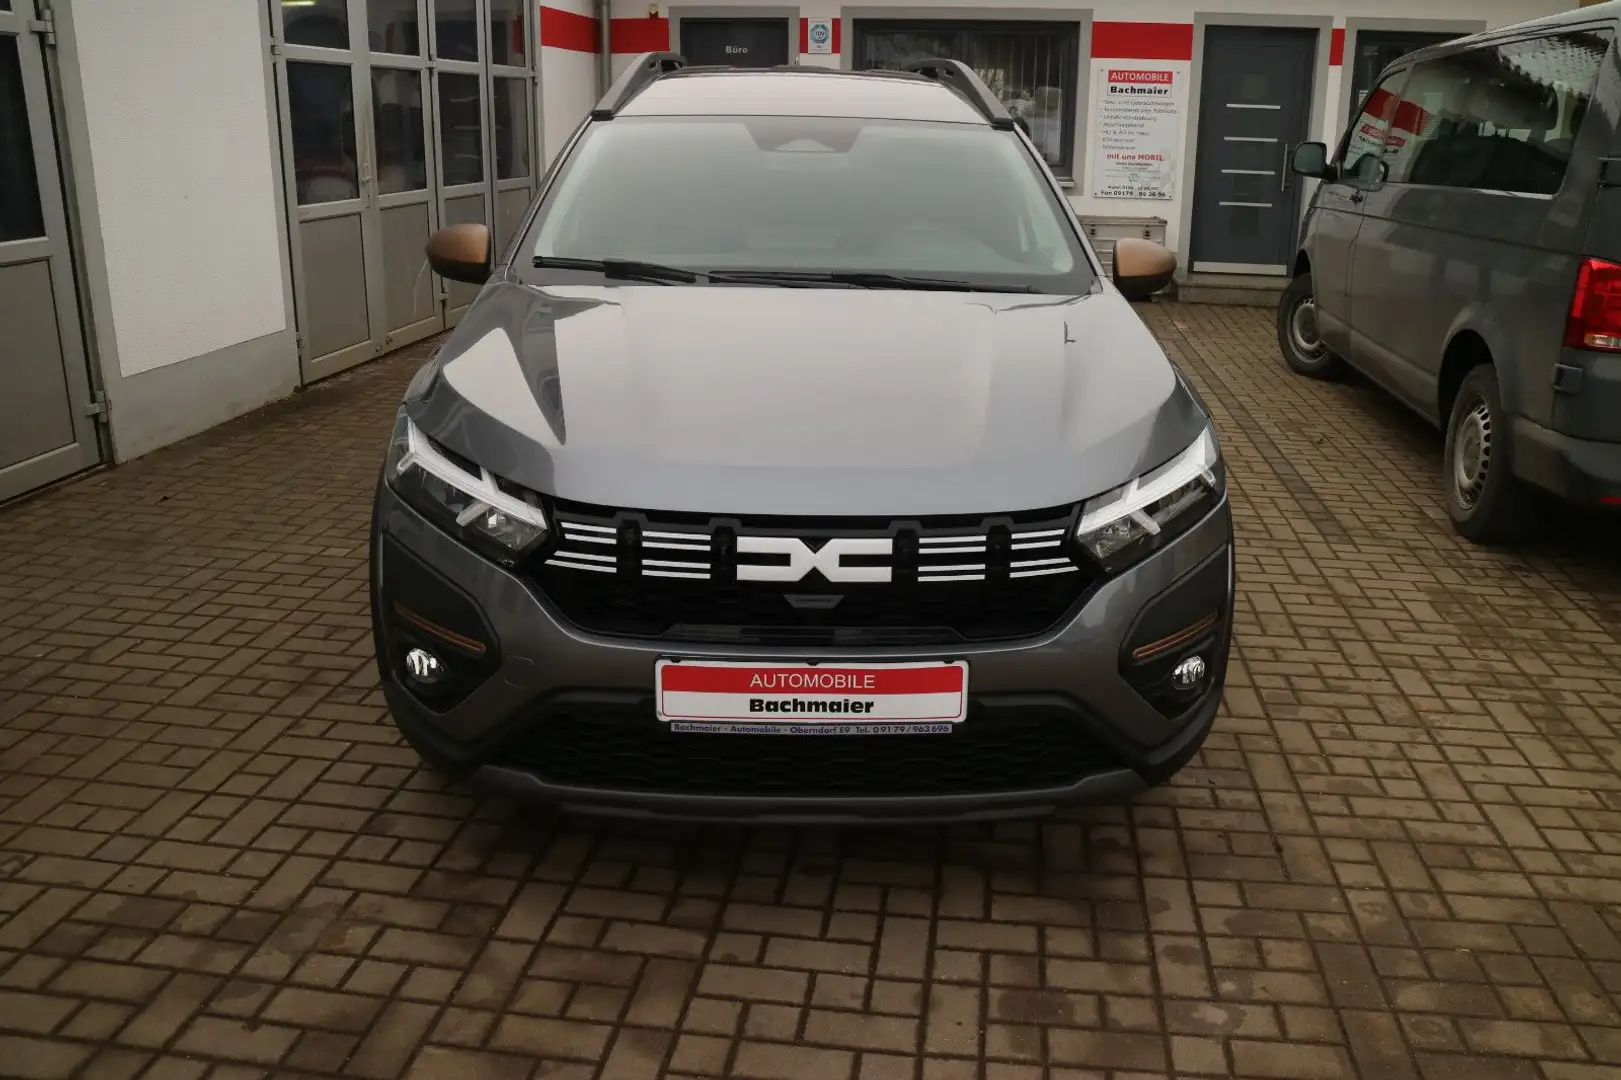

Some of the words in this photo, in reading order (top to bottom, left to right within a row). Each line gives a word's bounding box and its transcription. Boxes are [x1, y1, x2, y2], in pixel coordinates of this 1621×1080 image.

[725, 45, 748, 54] Büro
[1110, 72, 1169, 82] AUTOMOBILE
[1110, 85, 1169, 95] Bachmaier
[749, 673, 876, 689] AUTOMOBILE
[749, 698, 874, 713] Bachmaier
[674, 723, 721, 732] Bachmaier
[730, 725, 781, 733] Automobile
[790, 725, 837, 734] Oberndorf
[856, 726, 870, 734] Tel.
